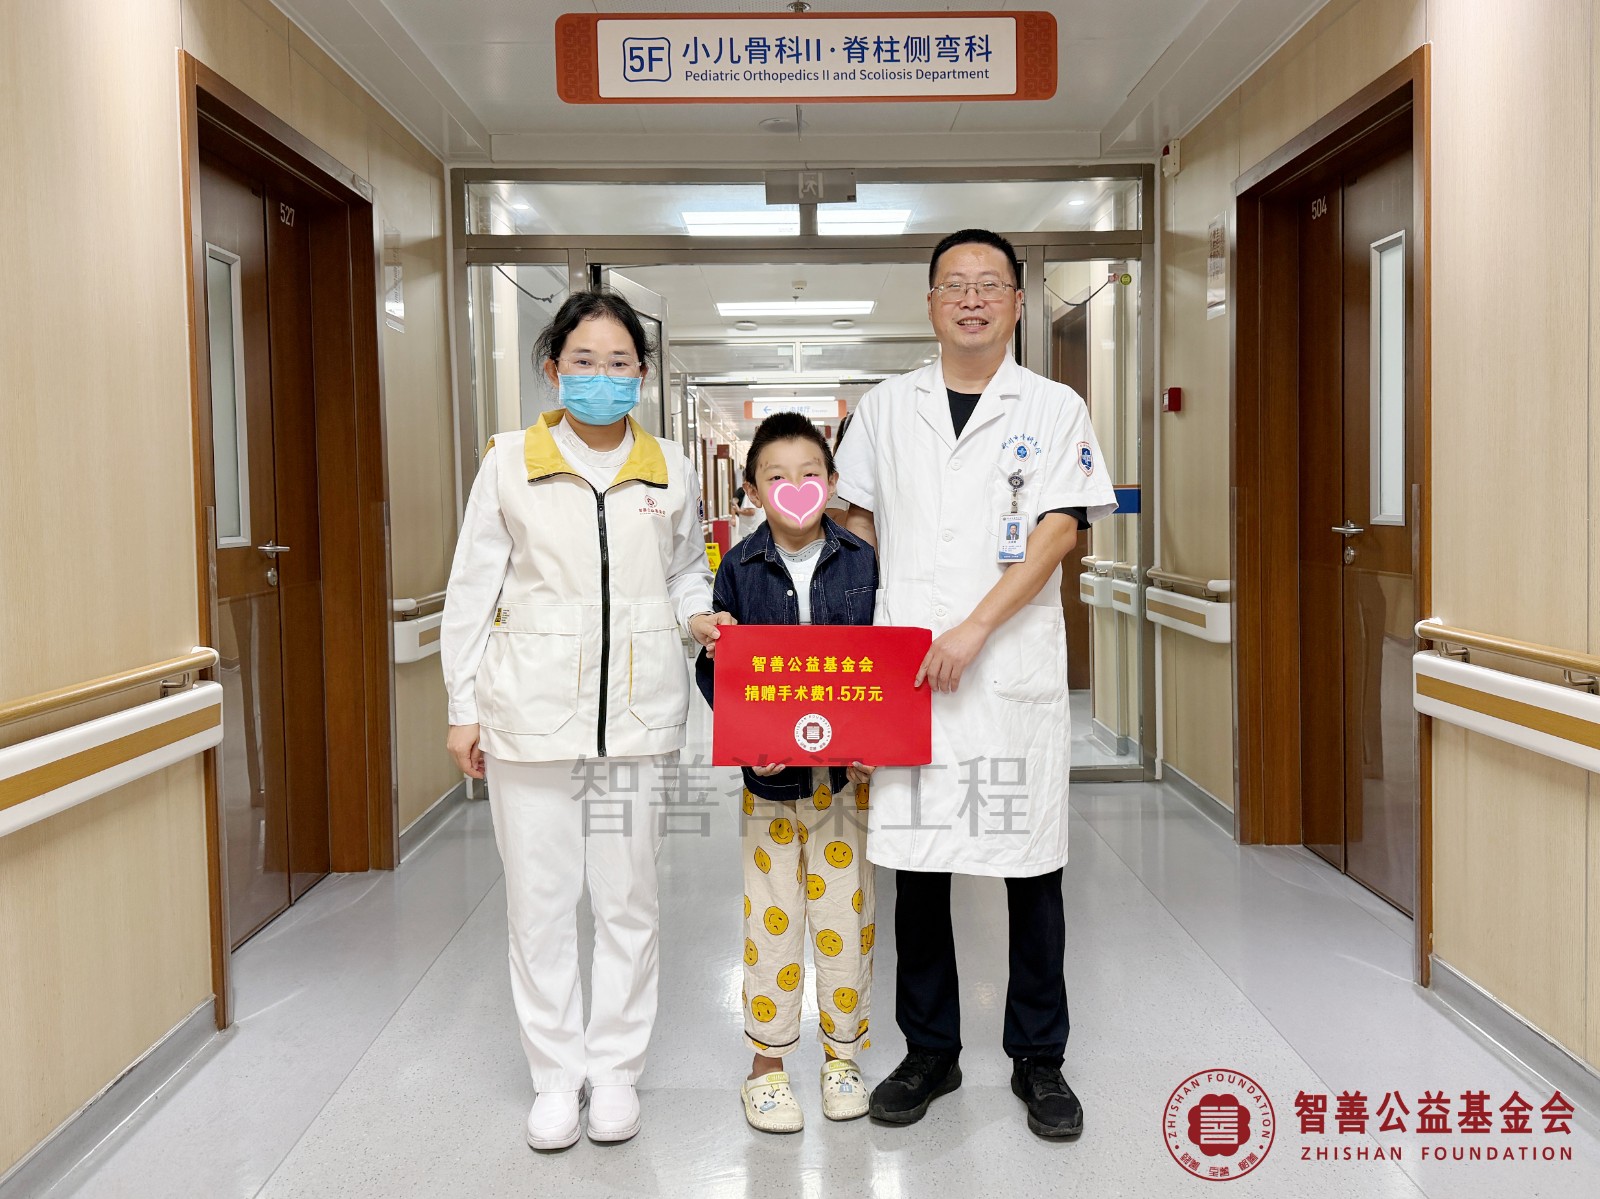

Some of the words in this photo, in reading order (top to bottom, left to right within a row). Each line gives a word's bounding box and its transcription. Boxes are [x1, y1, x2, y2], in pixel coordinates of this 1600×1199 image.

[629, 46, 665, 73] 5F
[682, 34, 993, 65] 小儿骨科II·脊柱侧弯科
[685, 70, 740, 82] Pediatric
[743, 69, 819, 84] Orthopedics
[822, 69, 830, 81] II
[833, 69, 856, 81] and
[859, 68, 913, 81] Scoliosis
[915, 68, 990, 82] Department
[280, 202, 295, 228] 527
[1311, 195, 1328, 220] 504
[752, 655, 874, 673] 智善公益基金会
[745, 684, 884, 702] 捐赠手术费1.5万元
